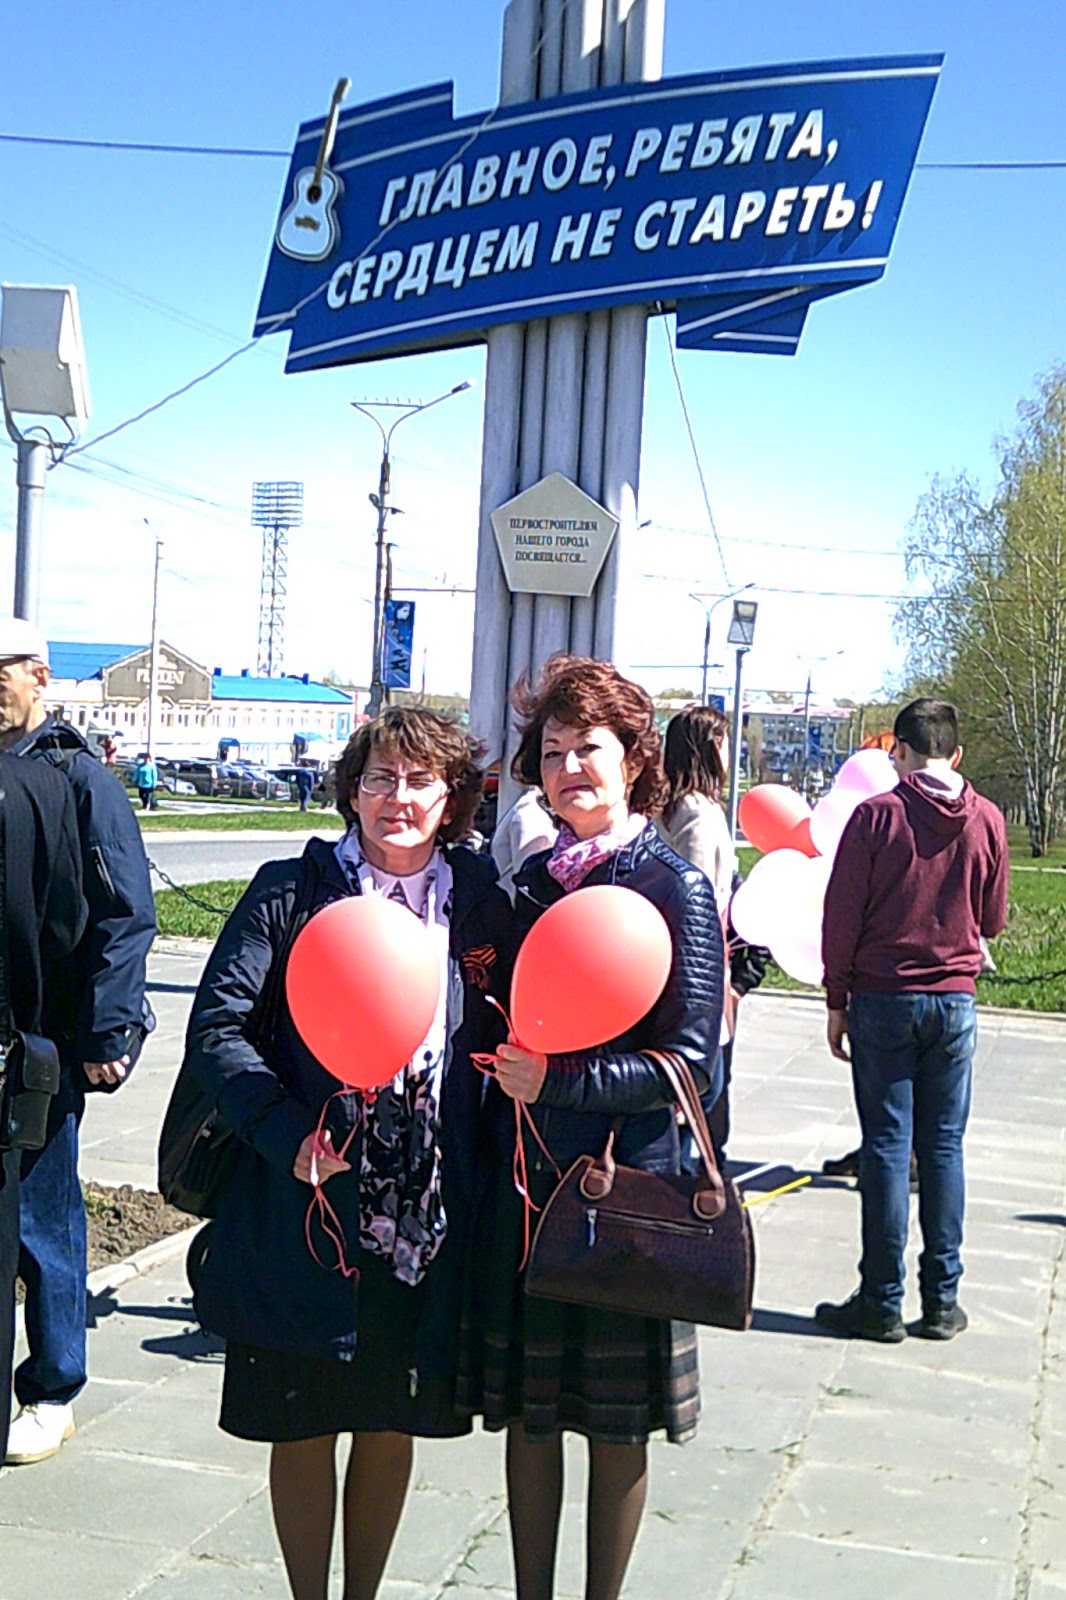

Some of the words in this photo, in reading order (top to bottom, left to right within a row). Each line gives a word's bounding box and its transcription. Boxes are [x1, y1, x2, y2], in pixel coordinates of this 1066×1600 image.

[378, 134, 616, 226] ГЛАВНОЕ,
[624, 109, 838, 178] РЕБЯТА,
[327, 221, 539, 309] СЕРДЦЕМ
[550, 207, 622, 263] НЕ
[634, 180, 883, 251] СТАРЕТЬ!
[515, 534, 553, 546] НАШЕГО
[555, 535, 590, 548] ГОРОДА
